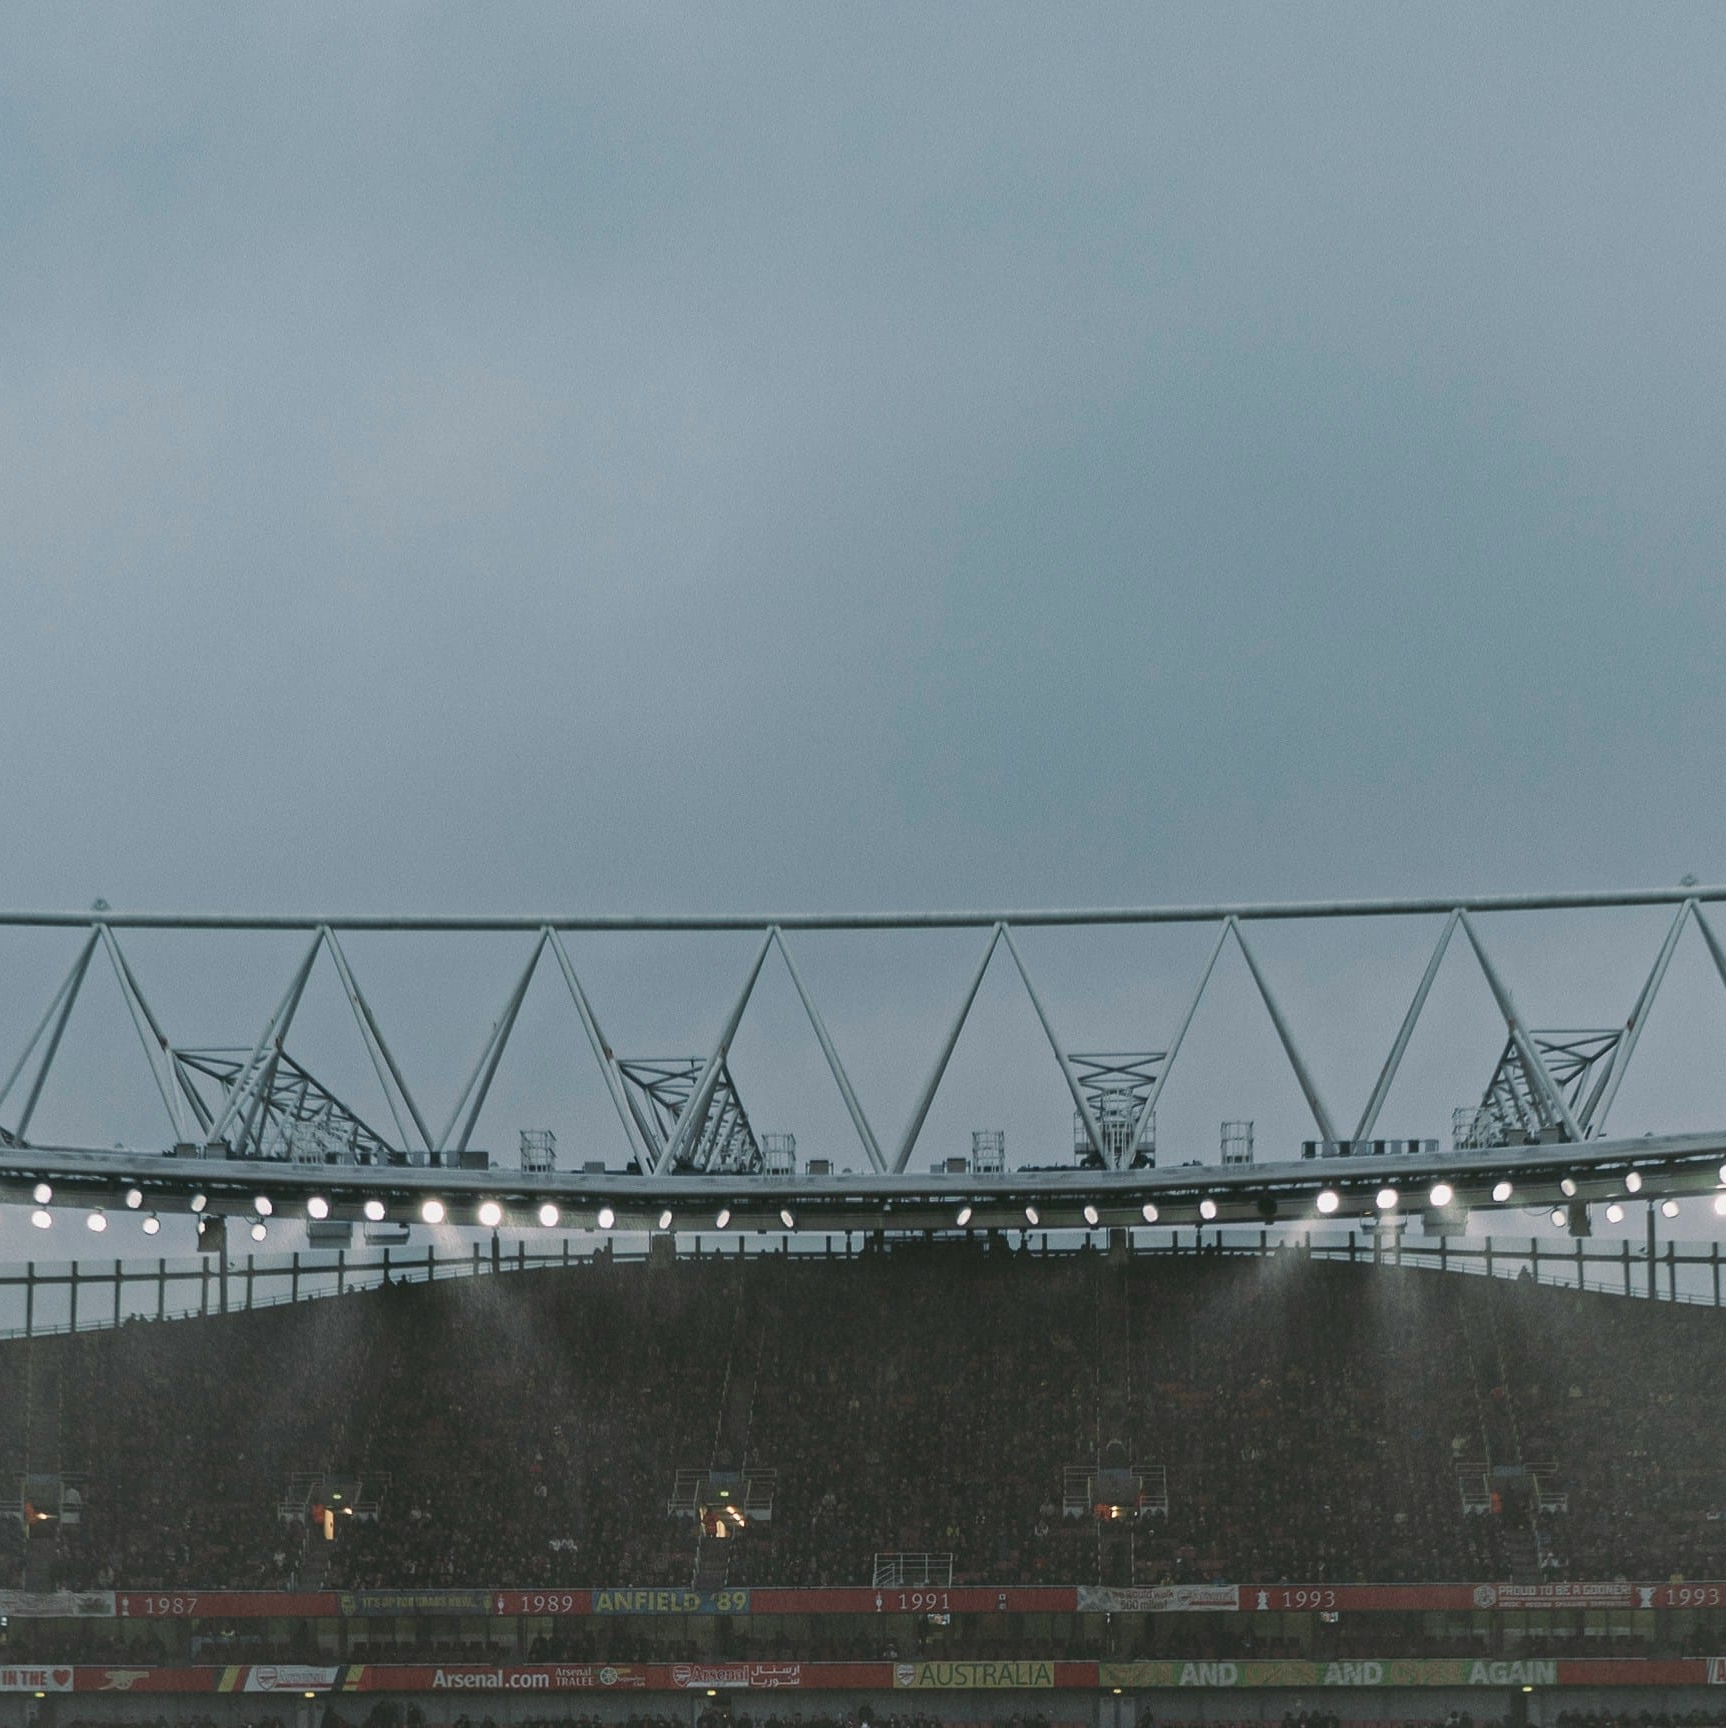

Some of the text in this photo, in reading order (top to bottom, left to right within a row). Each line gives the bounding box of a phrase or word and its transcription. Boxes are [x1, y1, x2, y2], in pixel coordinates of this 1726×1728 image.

[1499, 1584, 1536, 1596] PROUD
[1539, 1585, 1553, 1595] TO
[1555, 1584, 1571, 1595] BE
[1666, 1589, 1720, 1606] 1993
[145, 1597, 198, 1615] 1987
[521, 1596, 573, 1613] 1989
[595, 1591, 701, 1612] ANFIELD
[898, 1593, 950, 1610] 1991
[1282, 1591, 1336, 1609] 1993
[2, 1670, 17, 1686] IN
[20, 1670, 47, 1686] THE
[432, 1670, 550, 1689] Arsenal.com
[556, 1667, 592, 1677] Arsenal
[691, 1664, 749, 1682] Arsenal
[919, 1663, 1051, 1686] AUSTRALIA
[1179, 1661, 1556, 1686] AND AND AGAIN
[556, 1677, 595, 1687] TRALEE
